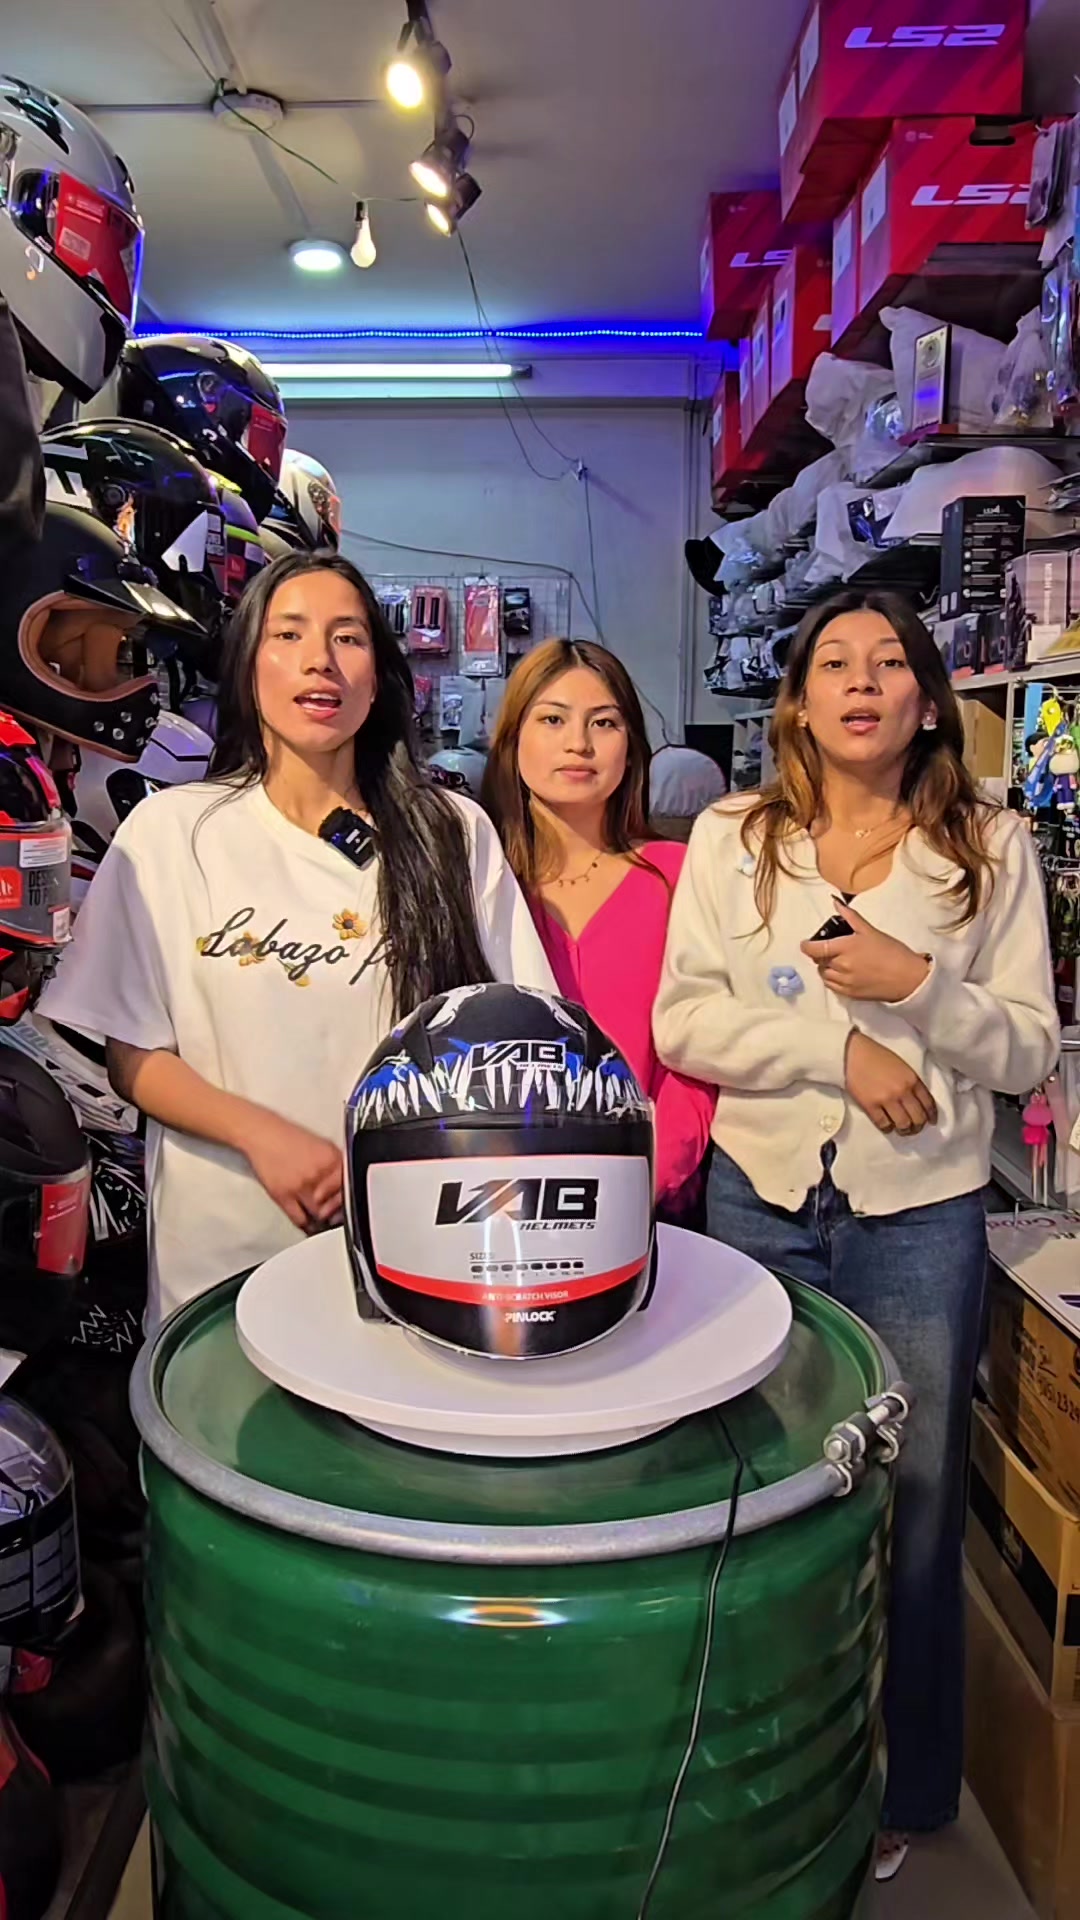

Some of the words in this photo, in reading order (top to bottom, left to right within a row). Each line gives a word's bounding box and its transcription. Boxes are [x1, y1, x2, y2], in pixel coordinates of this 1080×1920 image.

[844, 24, 1005, 48] LS2
[200, 907, 350, 981] Labazo
[470, 1040, 566, 1070] VAB
[435, 1178, 599, 1225] VAB
[519, 1221, 597, 1232] HELMETS
[544, 1290, 569, 1300] VISOR
[504, 1310, 557, 1324] PINLOCK
